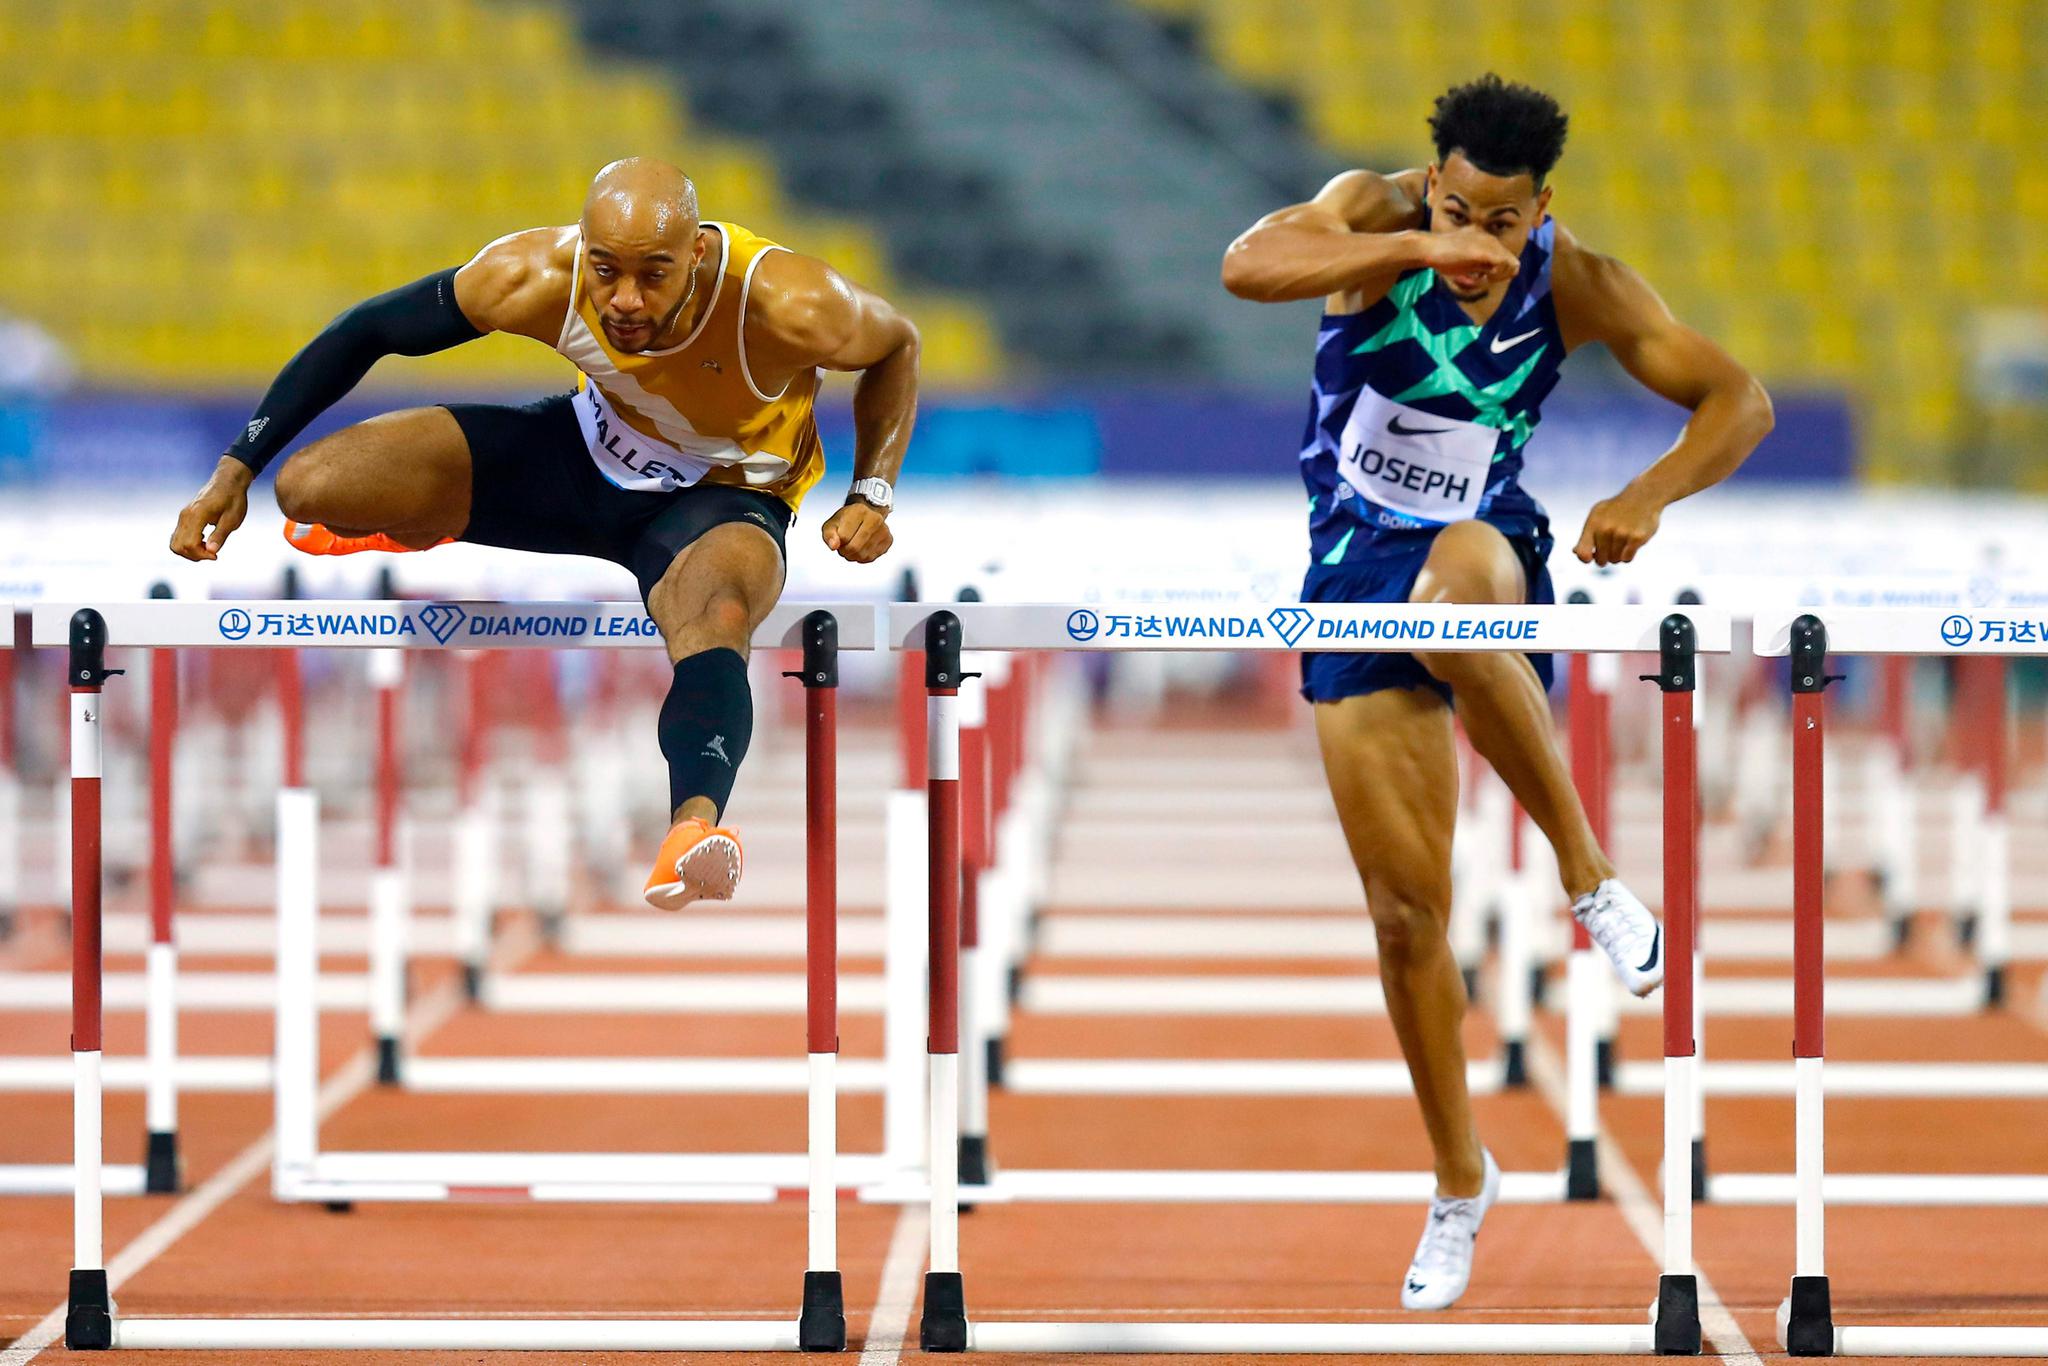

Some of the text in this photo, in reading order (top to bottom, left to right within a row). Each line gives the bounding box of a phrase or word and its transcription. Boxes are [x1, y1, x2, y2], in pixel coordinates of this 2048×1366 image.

[589, 387, 686, 483] MALLET
[1348, 443, 1469, 502] JOSEPH
[469, 615, 589, 636] DIAMOND
[1317, 618, 1436, 639] DIAMOND
[1441, 619, 1539, 640] LEAGUE
